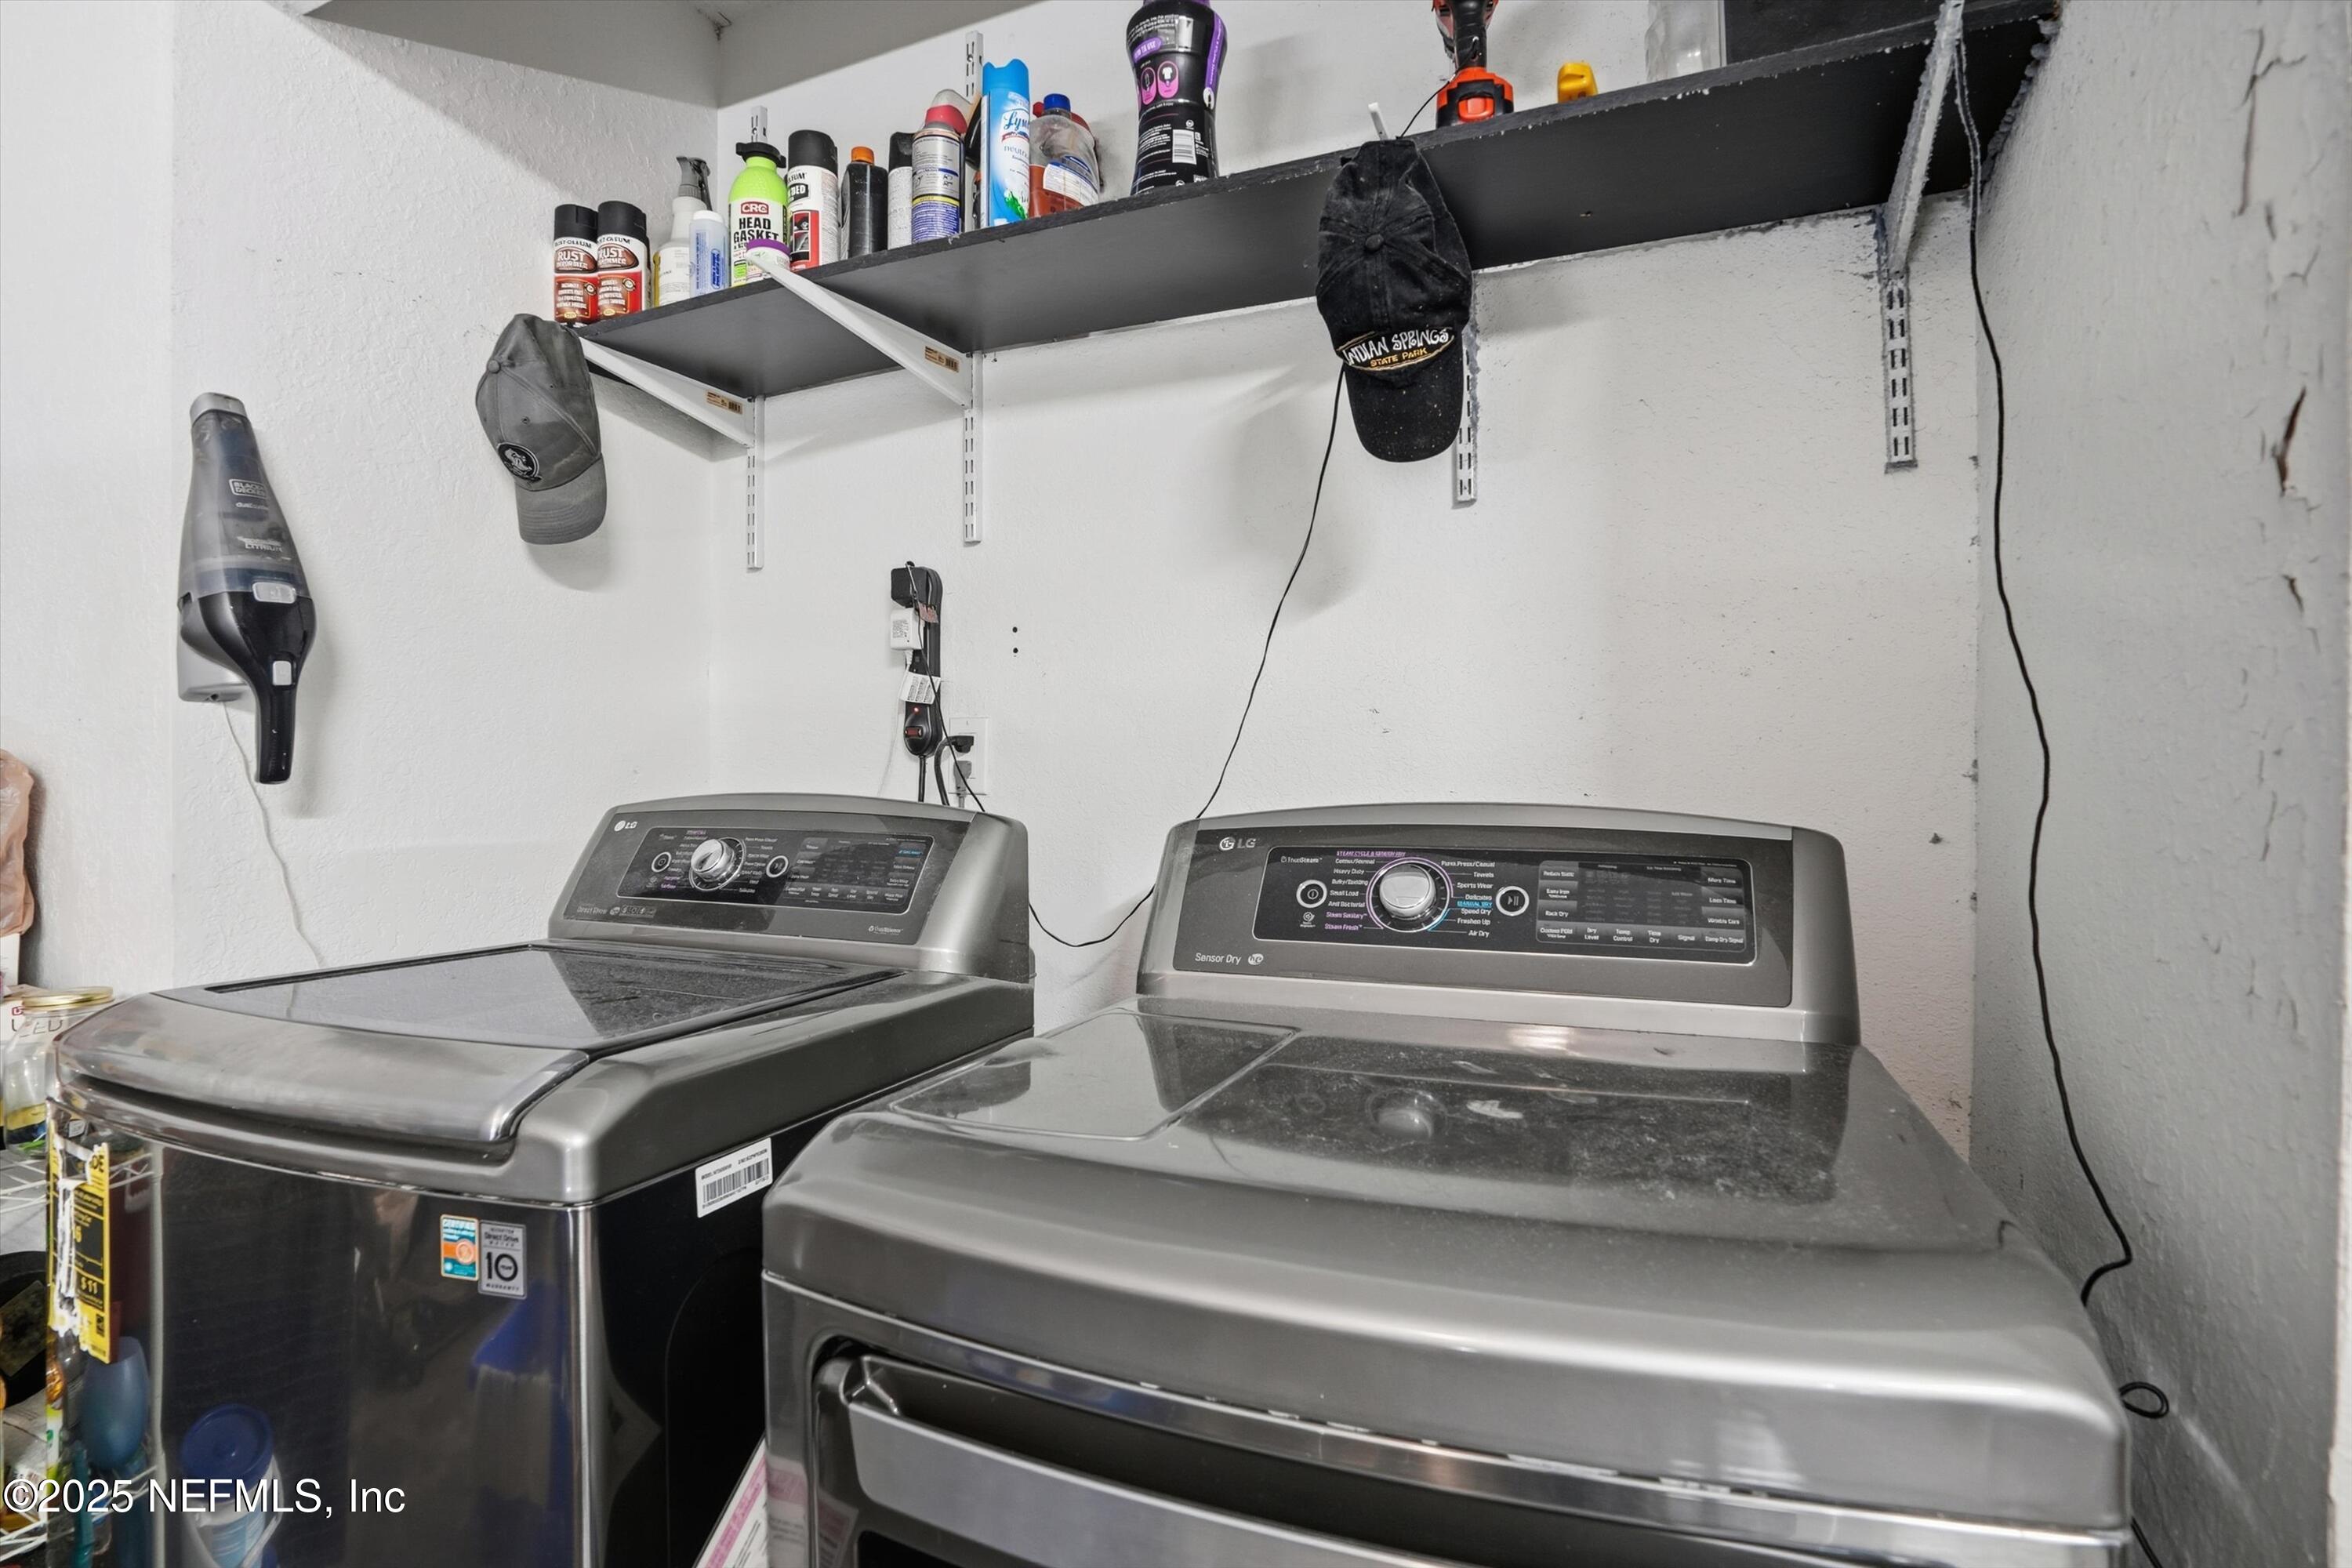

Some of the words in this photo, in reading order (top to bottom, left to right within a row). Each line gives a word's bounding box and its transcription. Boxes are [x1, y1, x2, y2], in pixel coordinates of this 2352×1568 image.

[742, 202, 768, 213] CRC
[739, 217, 771, 230] HEAD
[733, 230, 779, 245] GASKET
[557, 251, 585, 262] RUST
[1342, 337, 1389, 366] INDIAN
[1392, 328, 1450, 351] SPRINGS
[1370, 353, 1399, 368] STATE
[1402, 347, 1428, 360] PARK
[1195, 952, 1225, 963] Sensor
[1225, 954, 1241, 965] Dry
[485, 1251, 517, 1282] 10
[81, 1276, 98, 1294] $11
